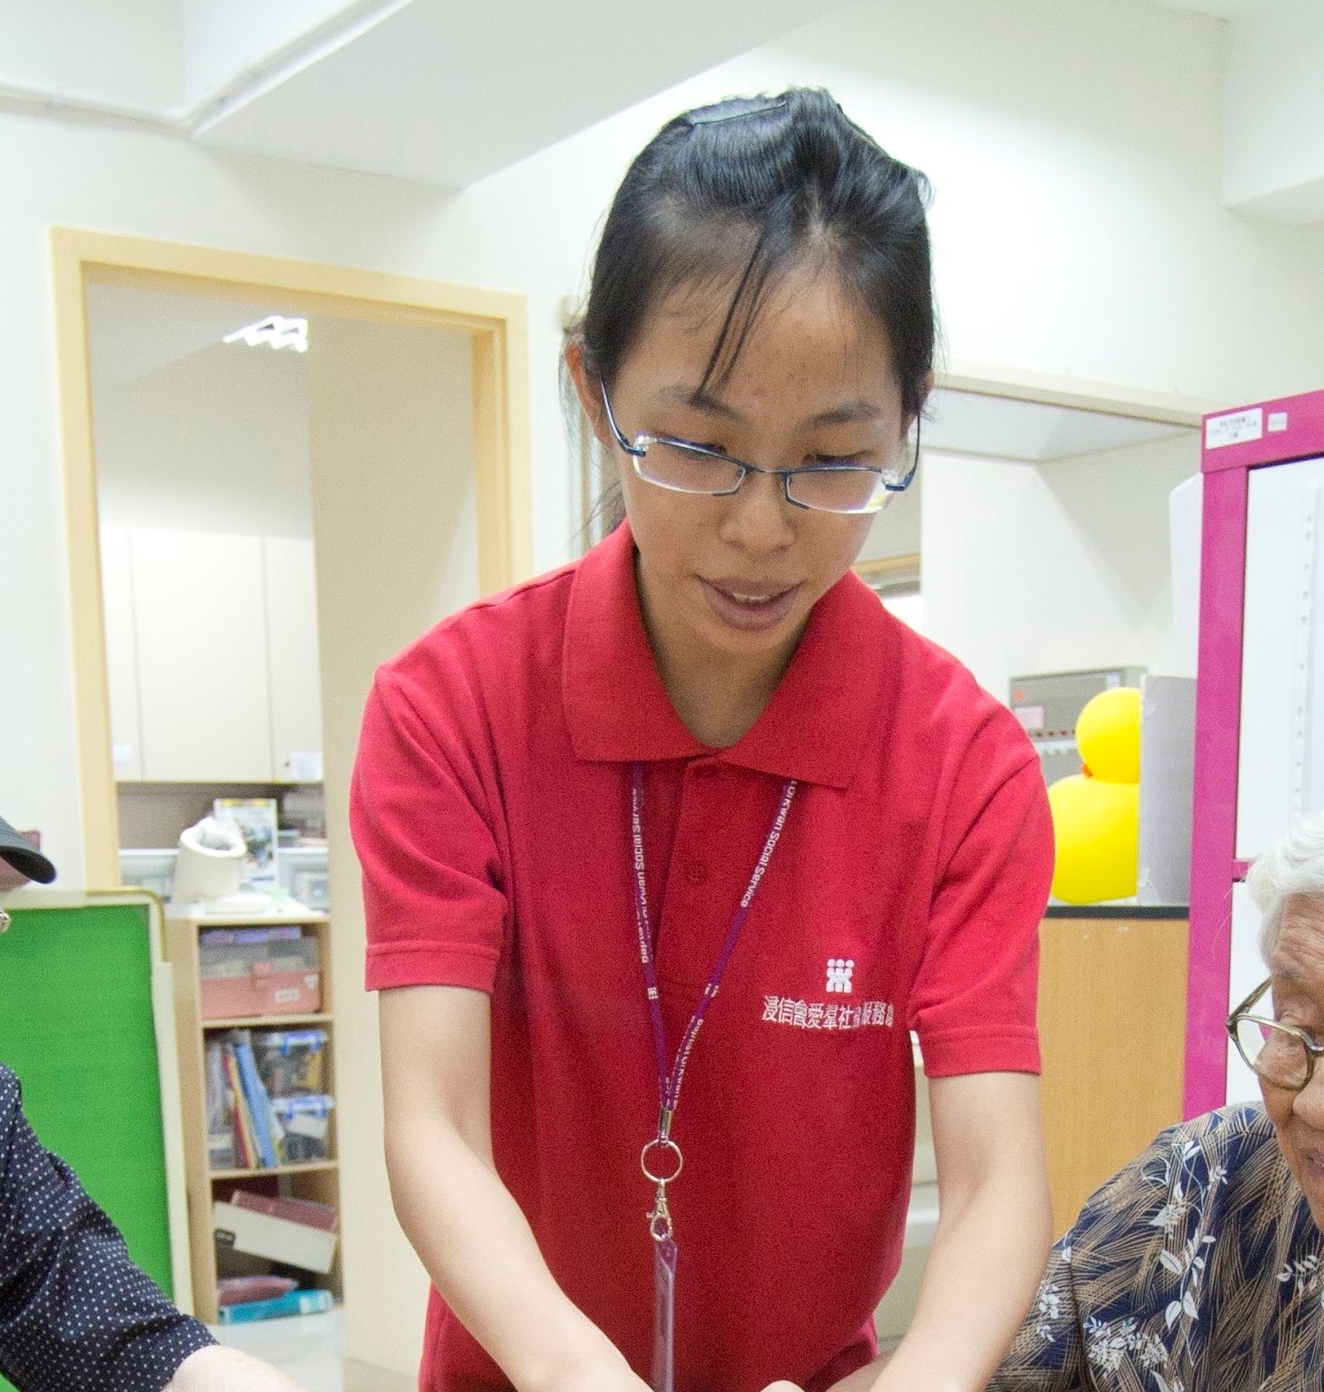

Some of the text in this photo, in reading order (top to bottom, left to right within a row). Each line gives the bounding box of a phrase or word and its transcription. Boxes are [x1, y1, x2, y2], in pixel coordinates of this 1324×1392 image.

[633, 834, 645, 871] Social
[758, 831, 780, 867] Social
[740, 865, 765, 908] Service
